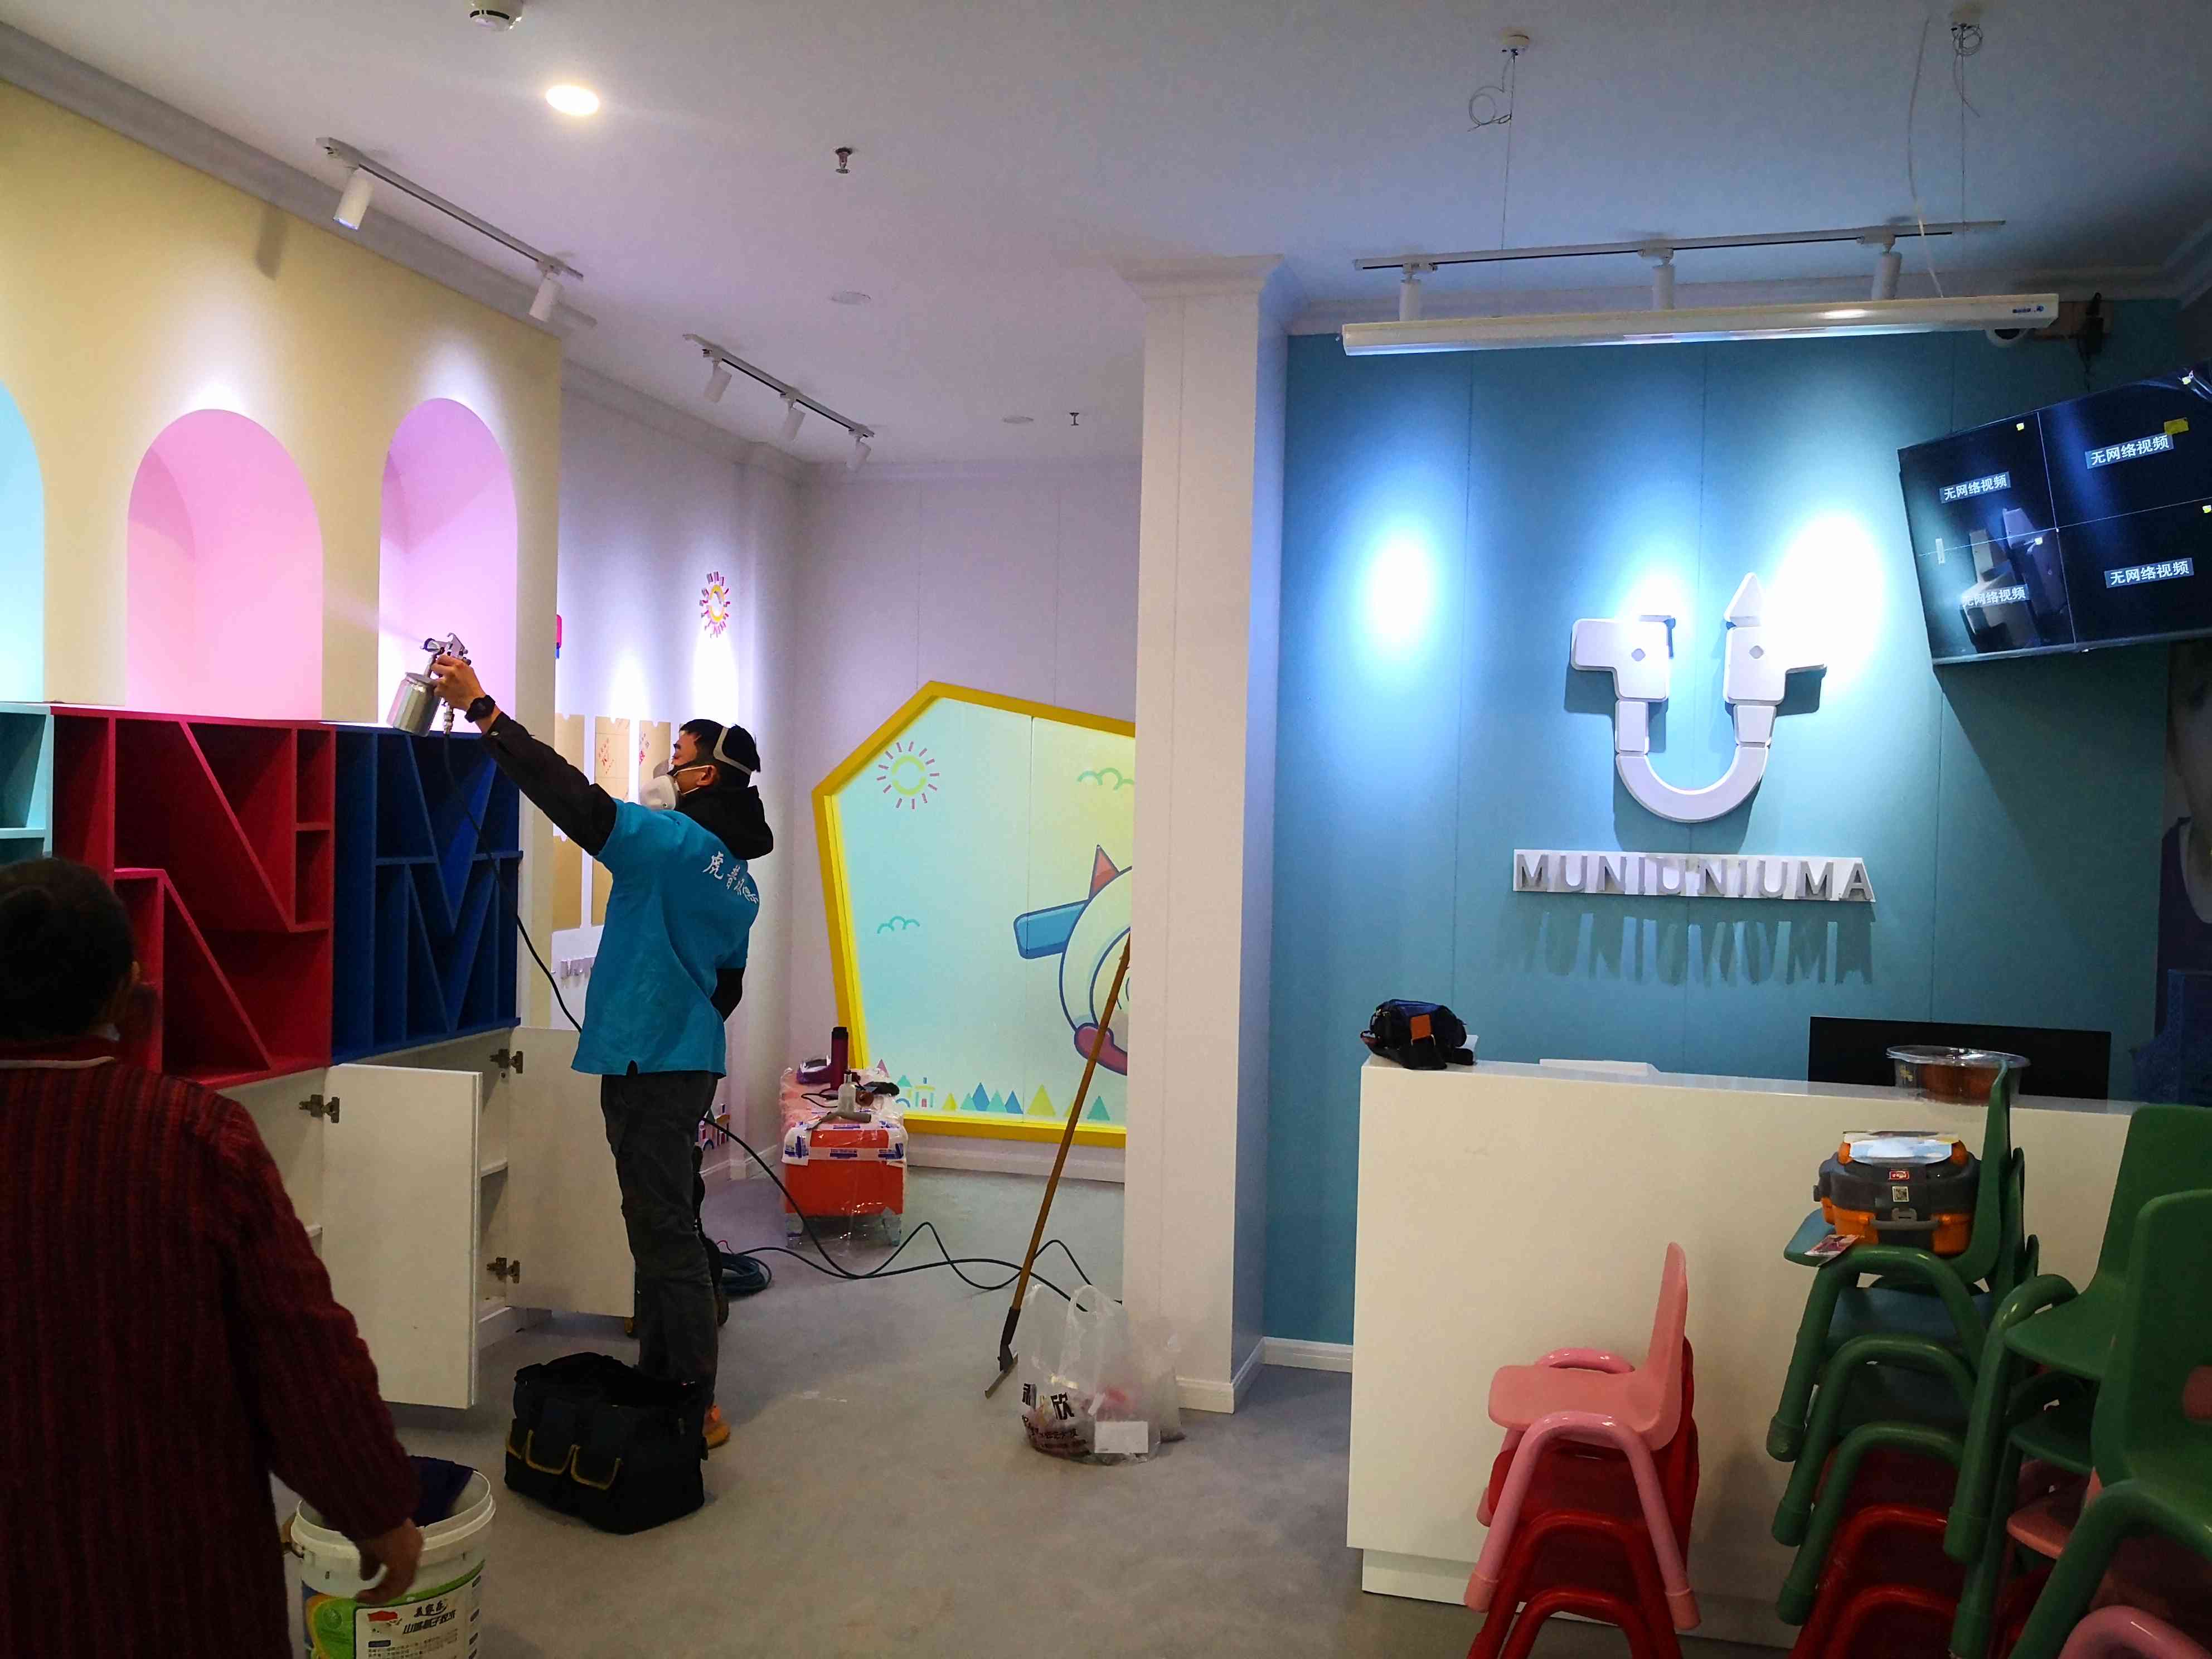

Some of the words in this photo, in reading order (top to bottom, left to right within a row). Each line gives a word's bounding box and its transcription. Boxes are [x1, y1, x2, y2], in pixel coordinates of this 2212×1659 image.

[2090, 434, 2170, 466] 无网络视频
[1943, 475, 2008, 501] 无网络视频
[2109, 561, 2190, 585] 无网络视频
[1962, 586, 2026, 608] 无网络视频
[1514, 851, 1875, 901] MUNIUNIUMA
